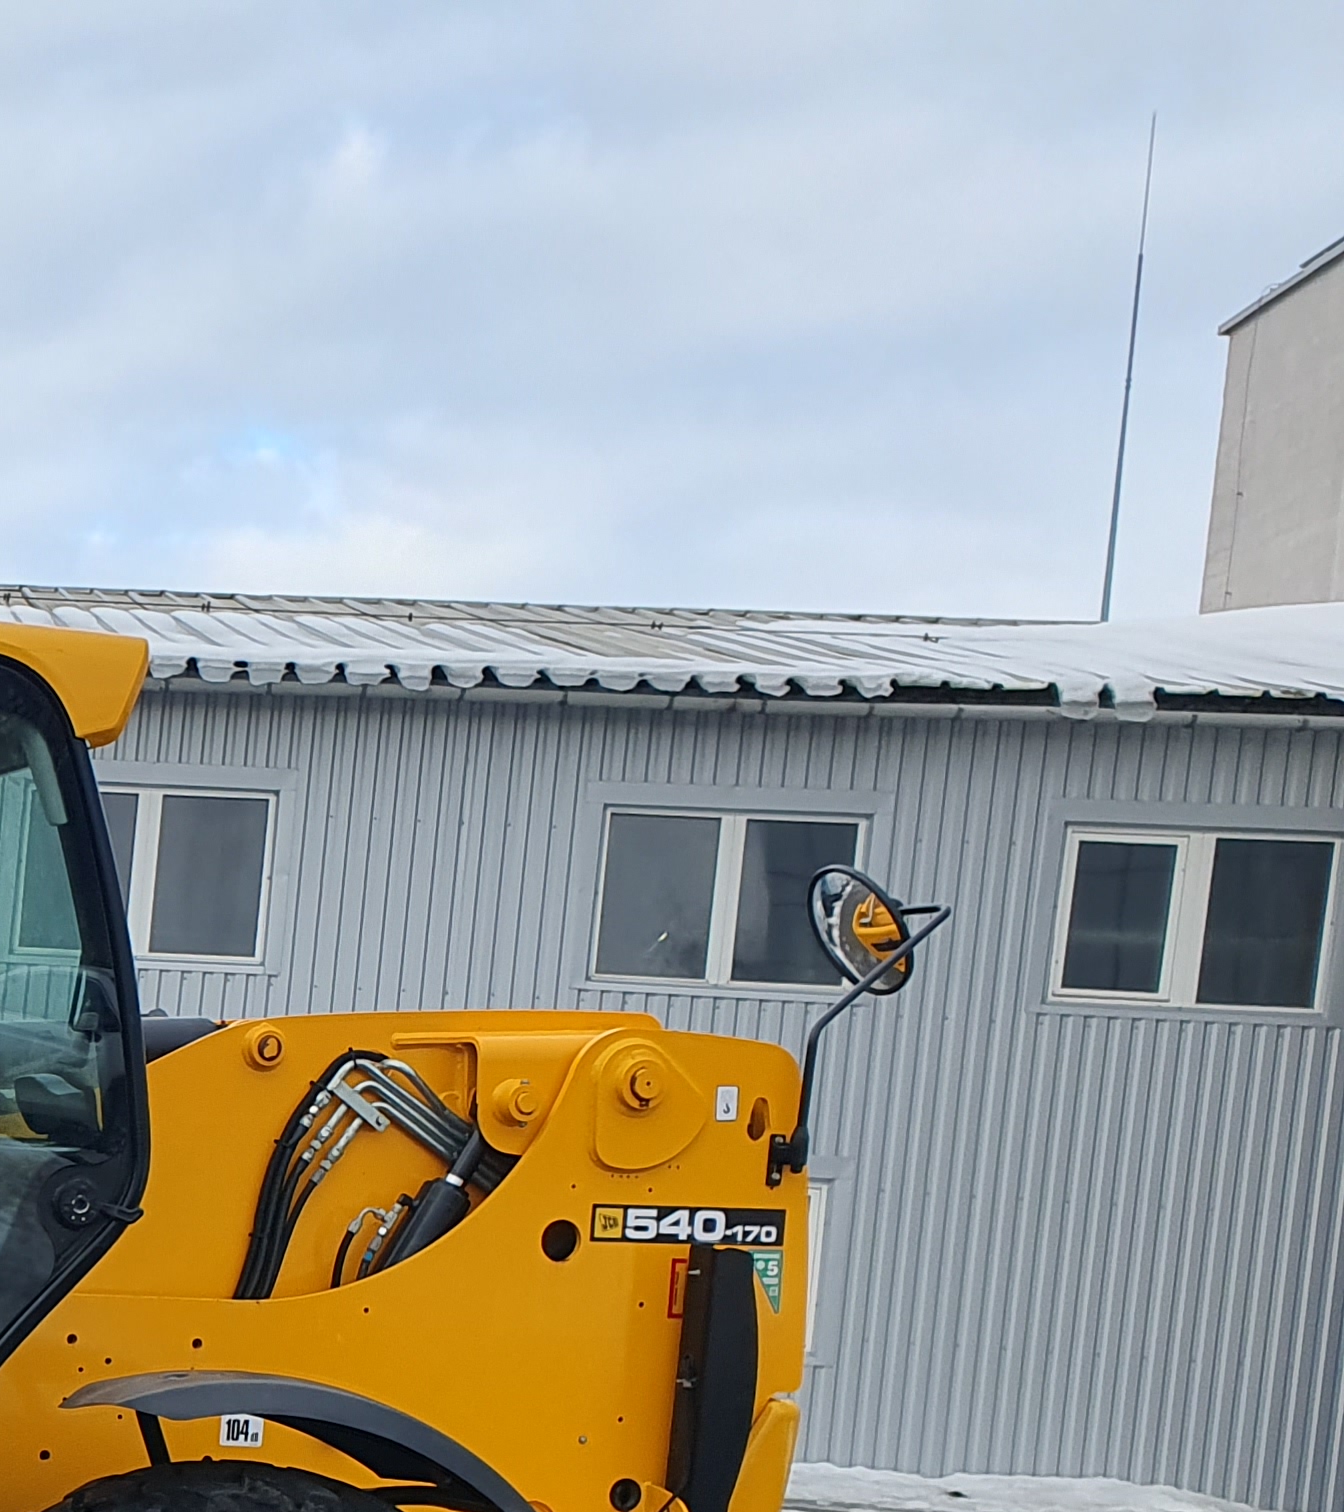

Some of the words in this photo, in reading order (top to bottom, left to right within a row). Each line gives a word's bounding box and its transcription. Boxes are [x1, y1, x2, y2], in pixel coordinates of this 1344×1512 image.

[625, 1208, 778, 1243] 540-170
[766, 1260, 779, 1276] 5
[226, 1418, 250, 1442] 104
